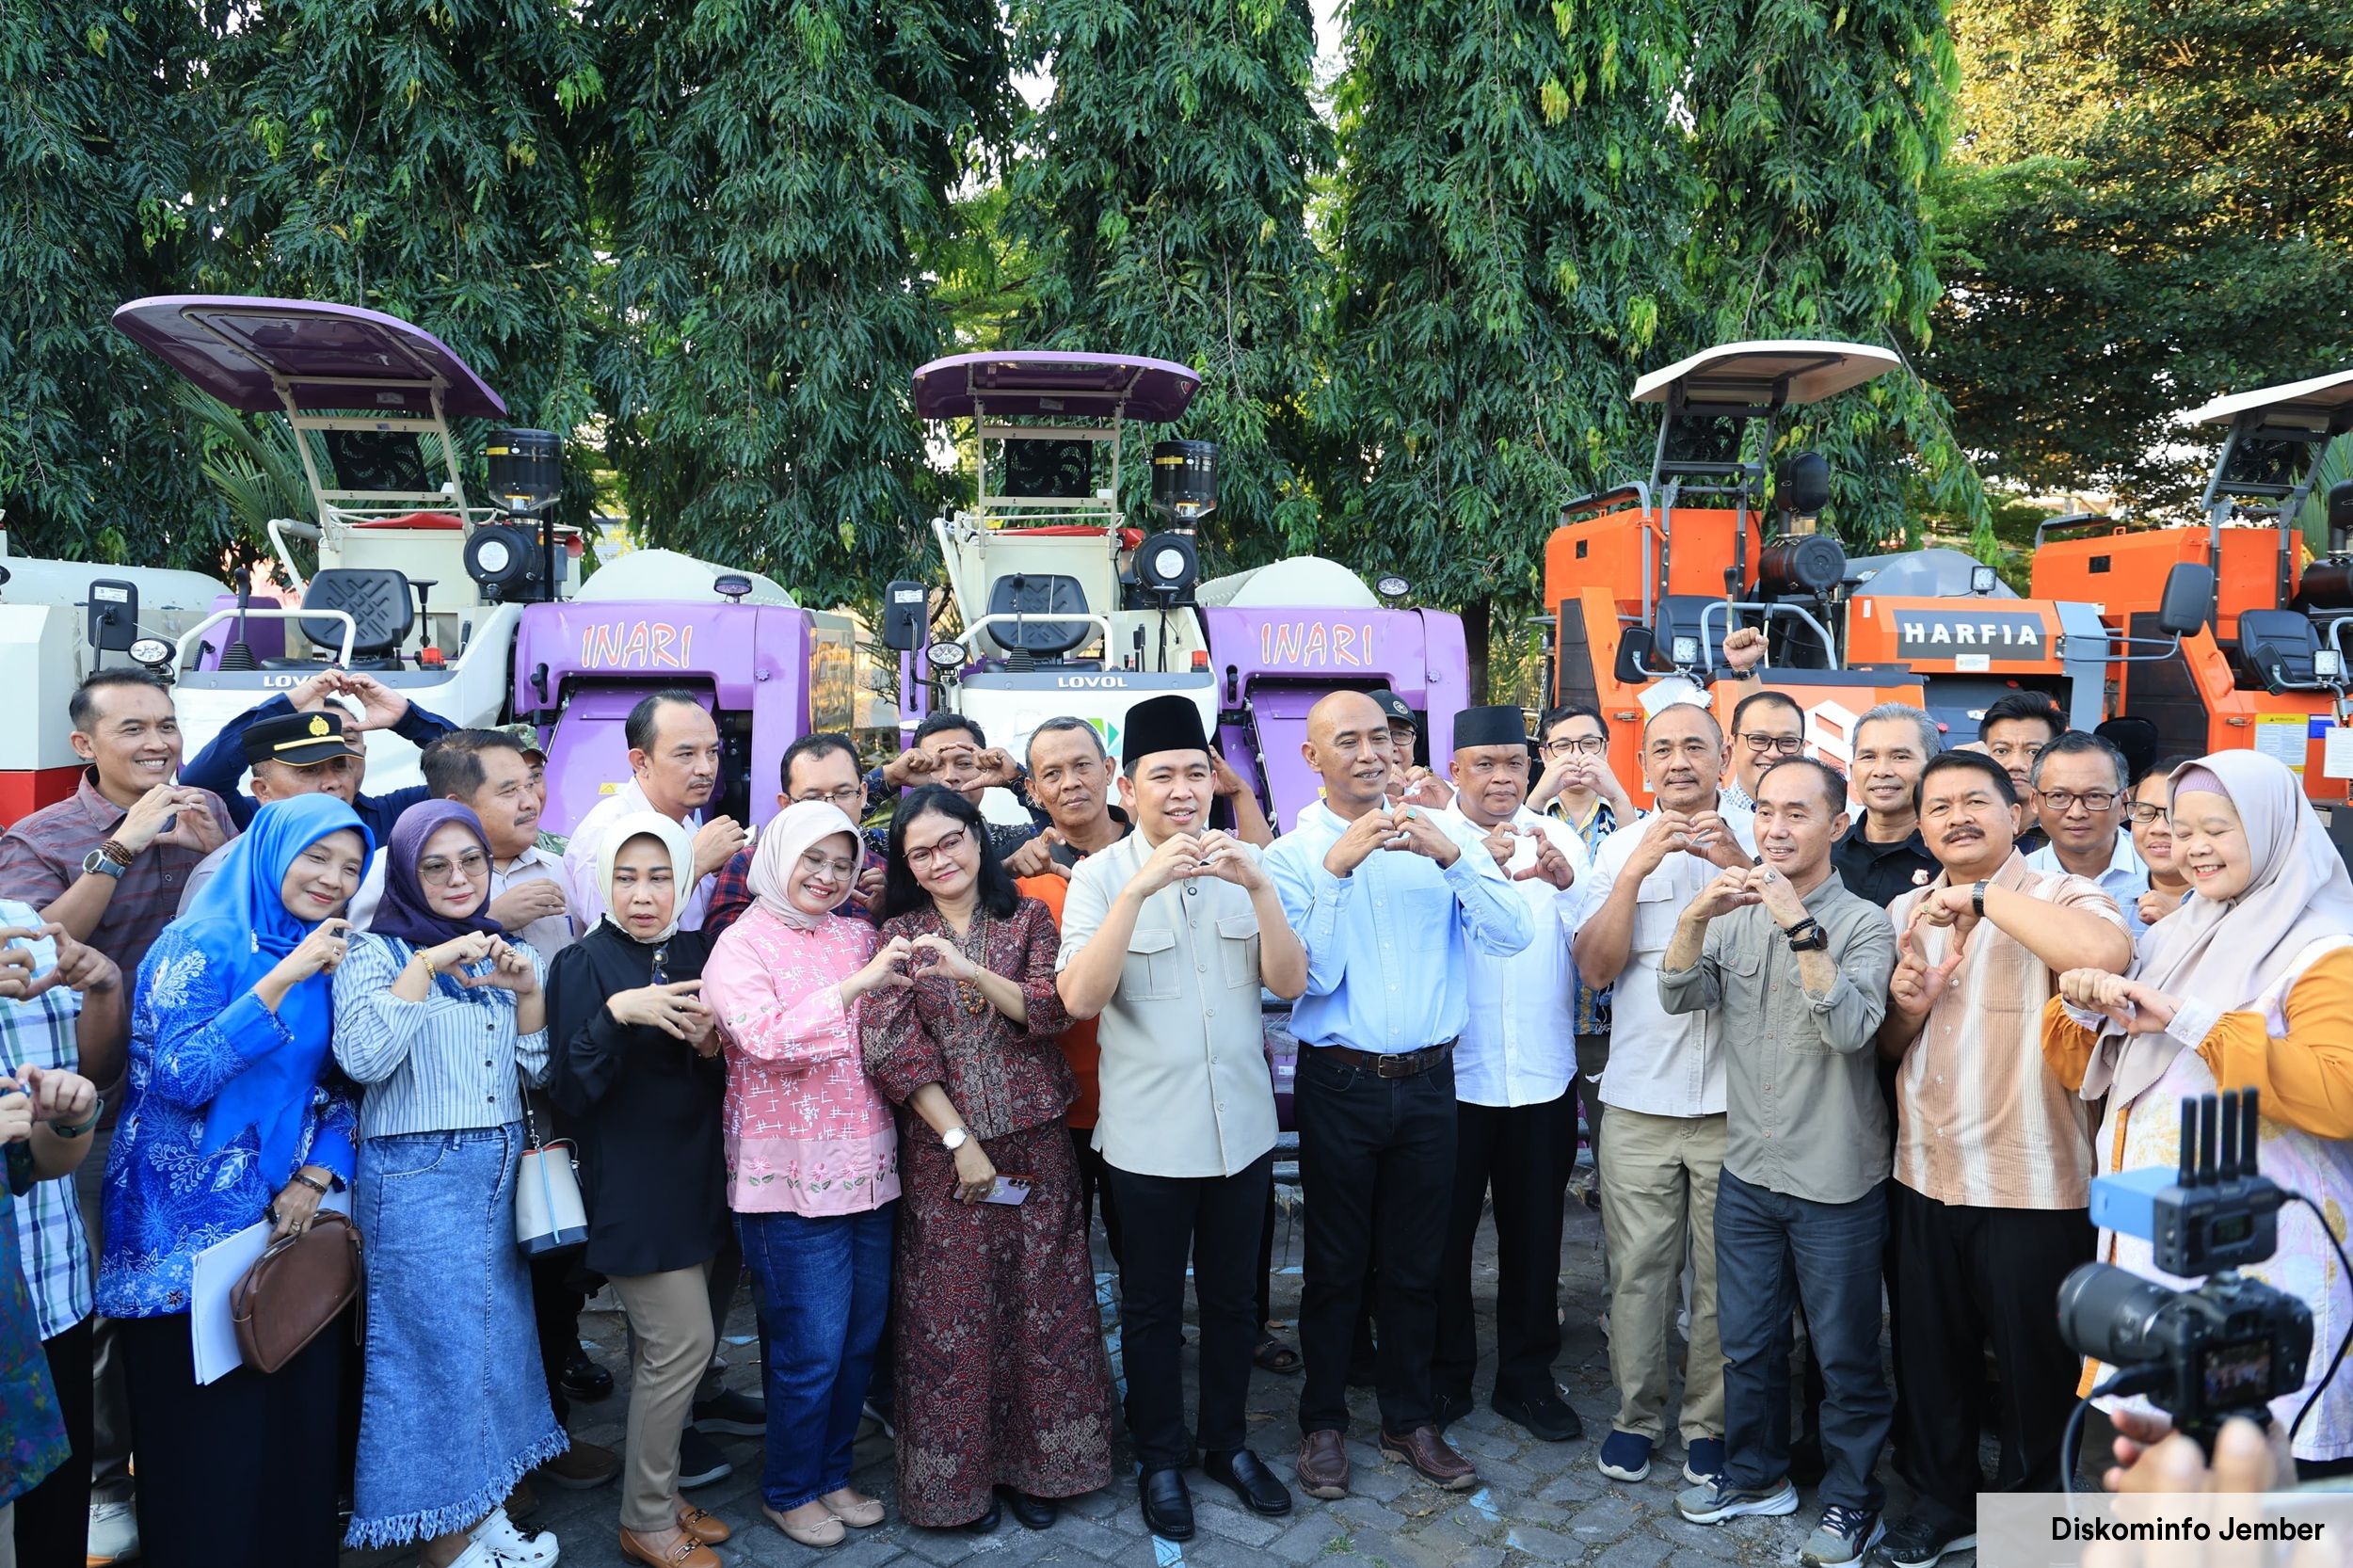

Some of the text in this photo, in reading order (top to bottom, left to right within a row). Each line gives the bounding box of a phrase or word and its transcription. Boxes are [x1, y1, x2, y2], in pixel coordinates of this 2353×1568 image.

[582, 621, 693, 668] INARI
[1261, 621, 1372, 666] INARI
[1904, 623, 2038, 645] HARFIA
[264, 675, 316, 687] LOV
[1058, 677, 1128, 688] LOVOL
